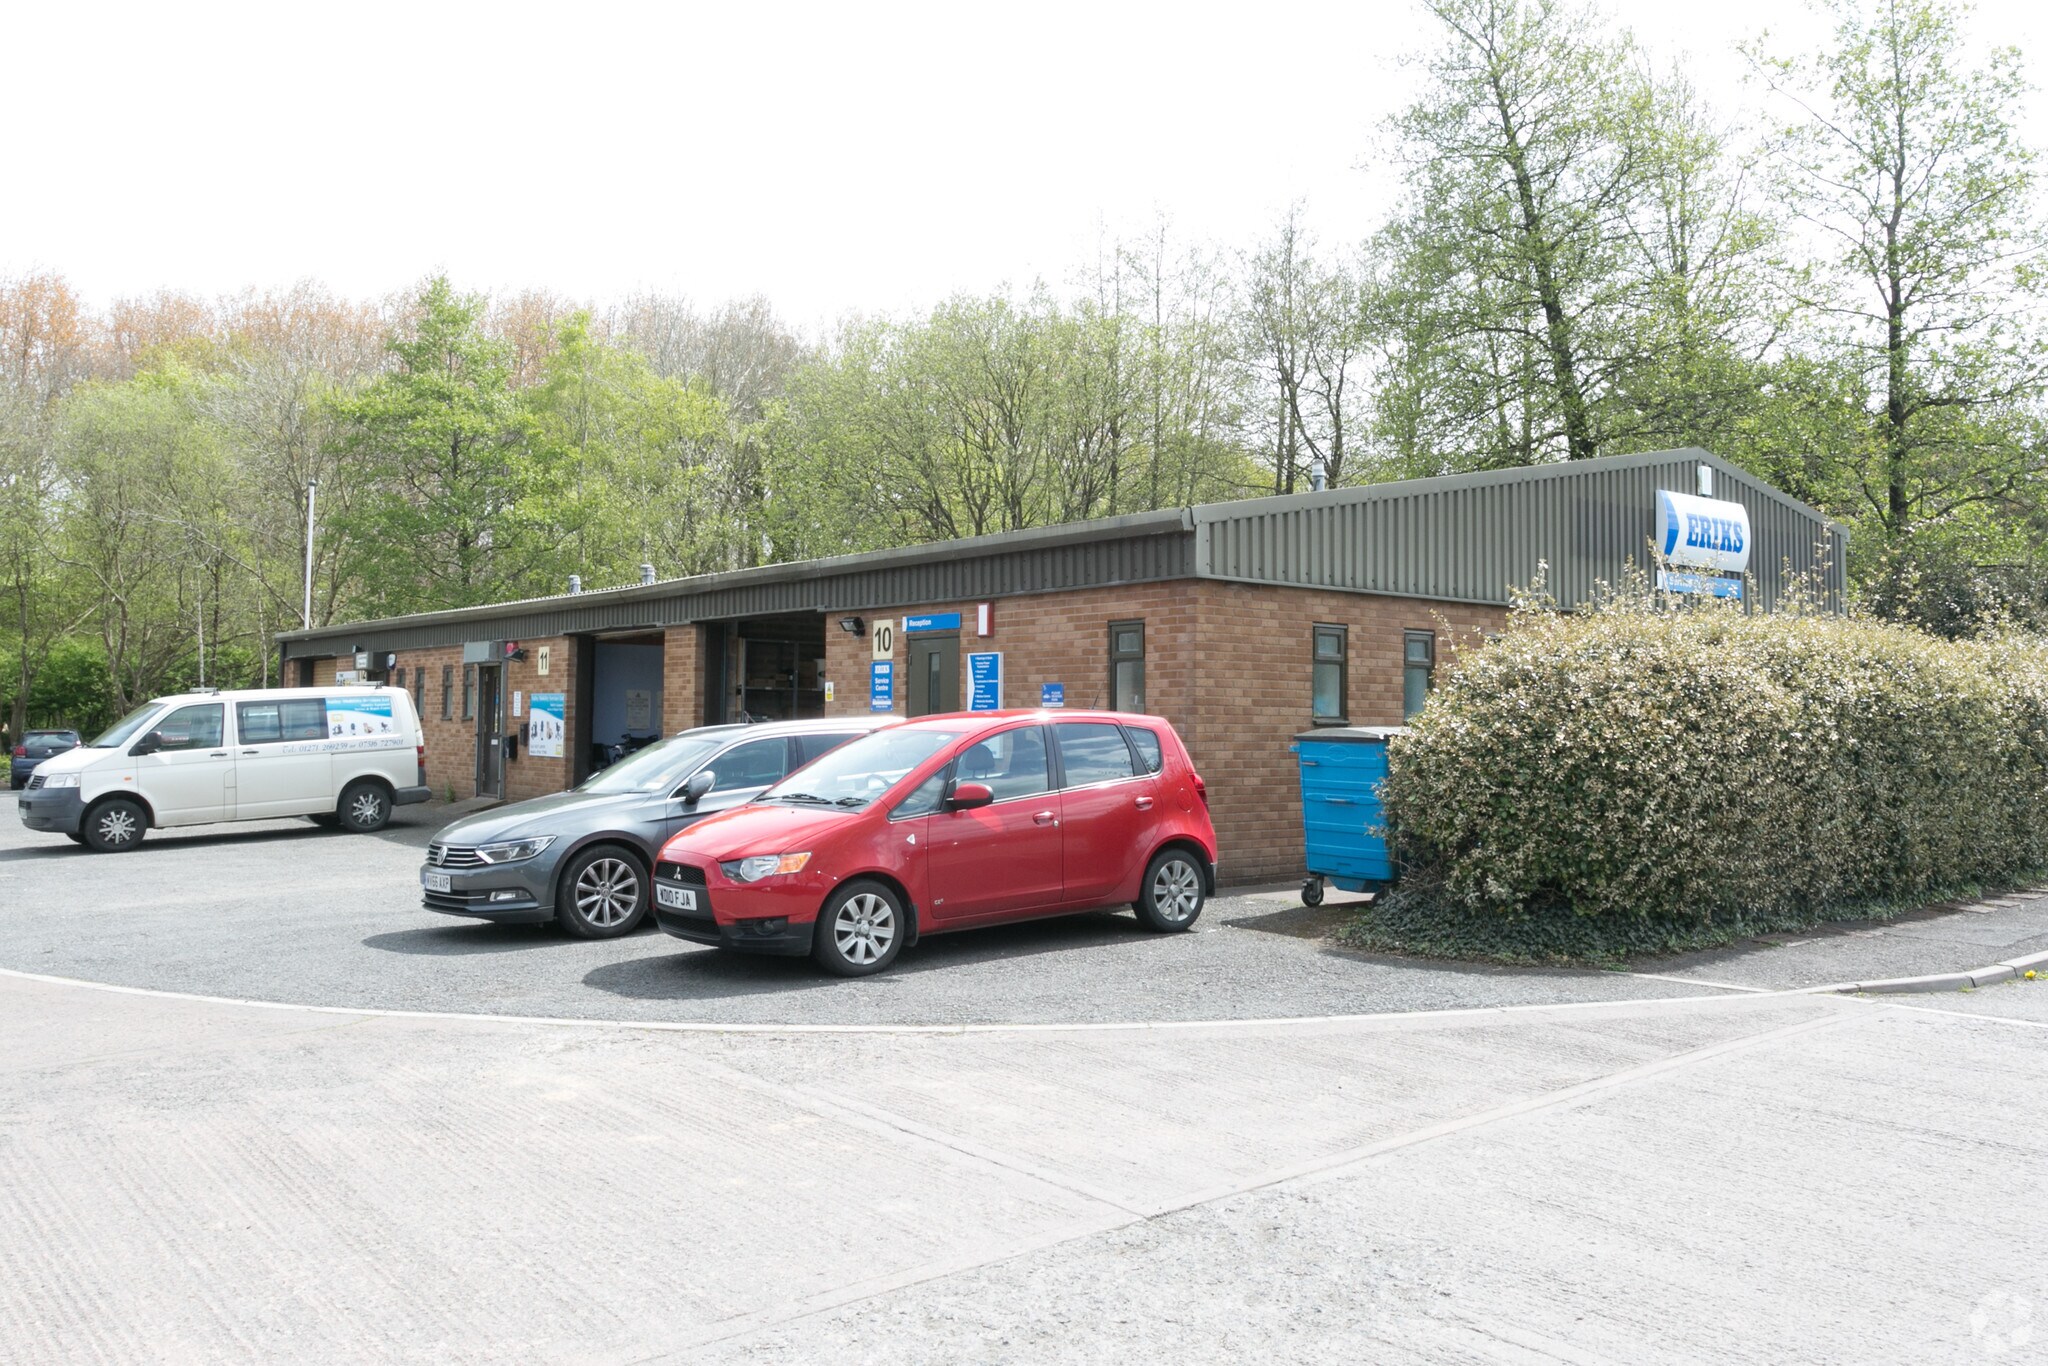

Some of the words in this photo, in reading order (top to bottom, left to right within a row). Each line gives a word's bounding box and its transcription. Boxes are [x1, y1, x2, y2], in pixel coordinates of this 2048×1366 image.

[1686, 513, 1744, 554] ERIKS
[909, 619, 932, 628] Reception
[875, 627, 892, 652] 10
[540, 652, 548, 670] 11
